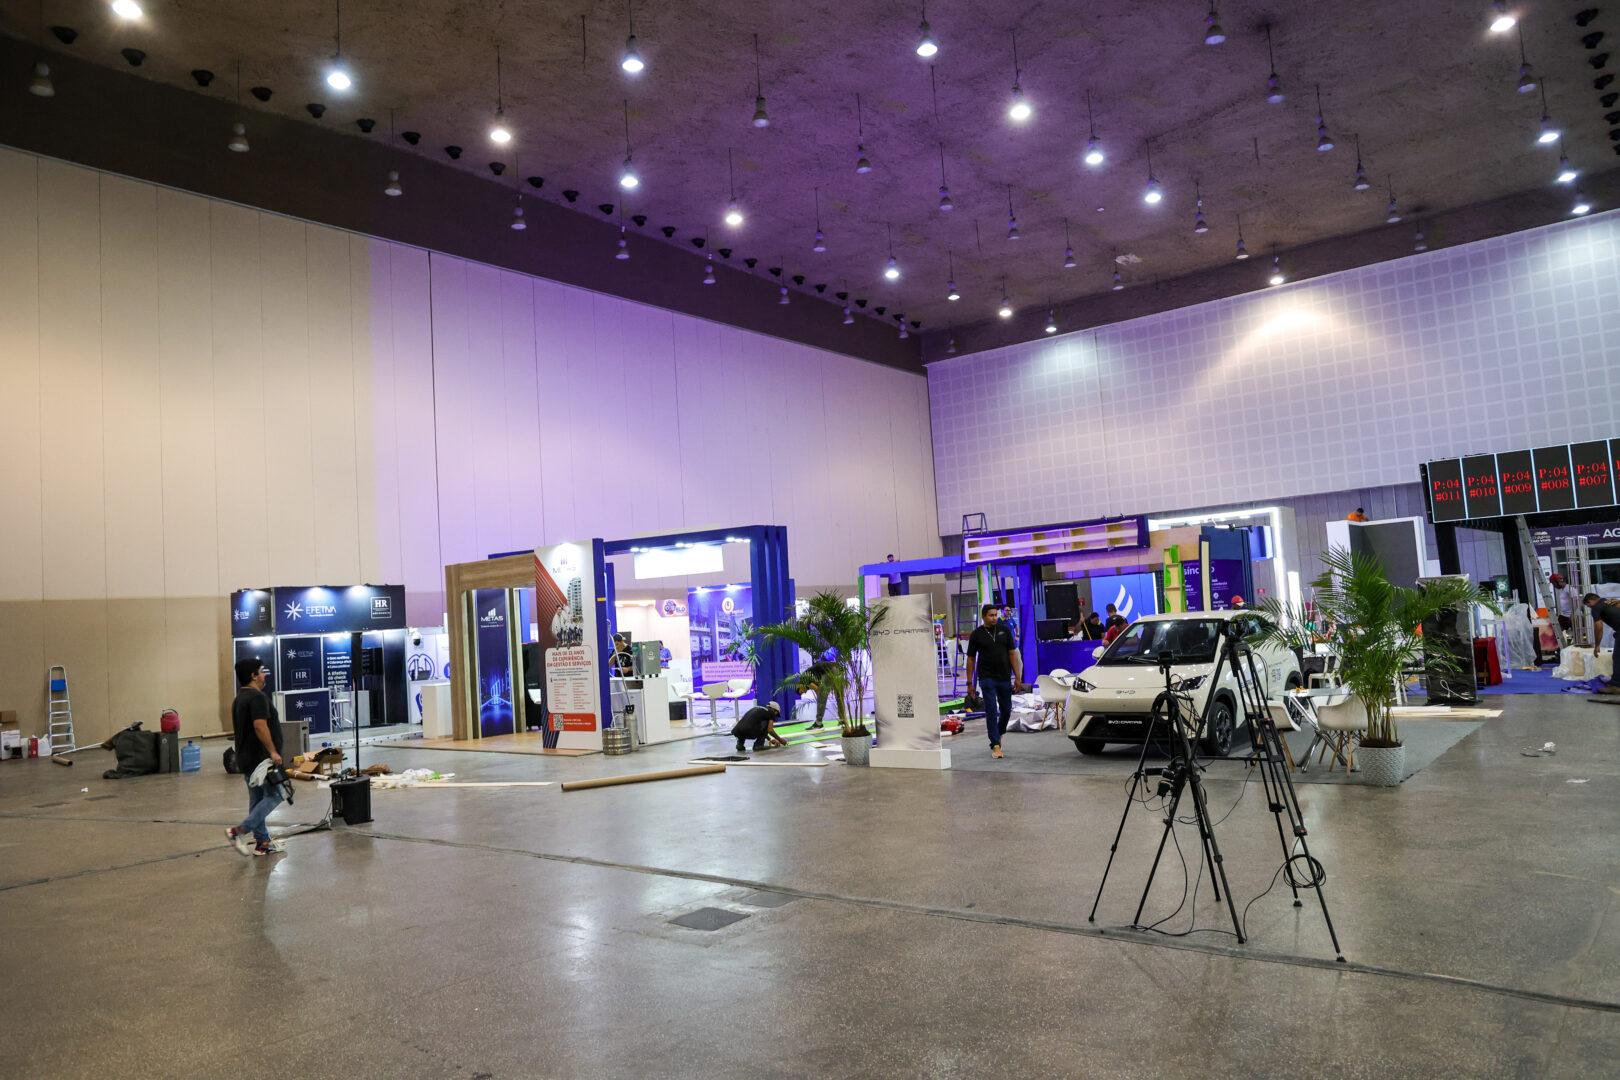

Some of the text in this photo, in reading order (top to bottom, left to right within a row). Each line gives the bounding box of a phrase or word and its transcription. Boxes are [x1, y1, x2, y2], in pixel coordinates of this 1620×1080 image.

[1539, 466, 1568, 478] P:04
[1576, 461, 1607, 474] P:04
[1467, 475, 1494, 486] P:04
[1503, 471, 1530, 483] P:04
[1579, 474, 1608, 486] #007
[1433, 479, 1460, 490] P:04
[1505, 482, 1532, 494] #009
[1541, 478, 1569, 490] #008
[1435, 490, 1460, 501] #011
[1469, 486, 1496, 498] #010
[306, 605, 337, 613] EFETIVA
[375, 600, 388, 608] HR
[295, 671, 308, 679] HR
